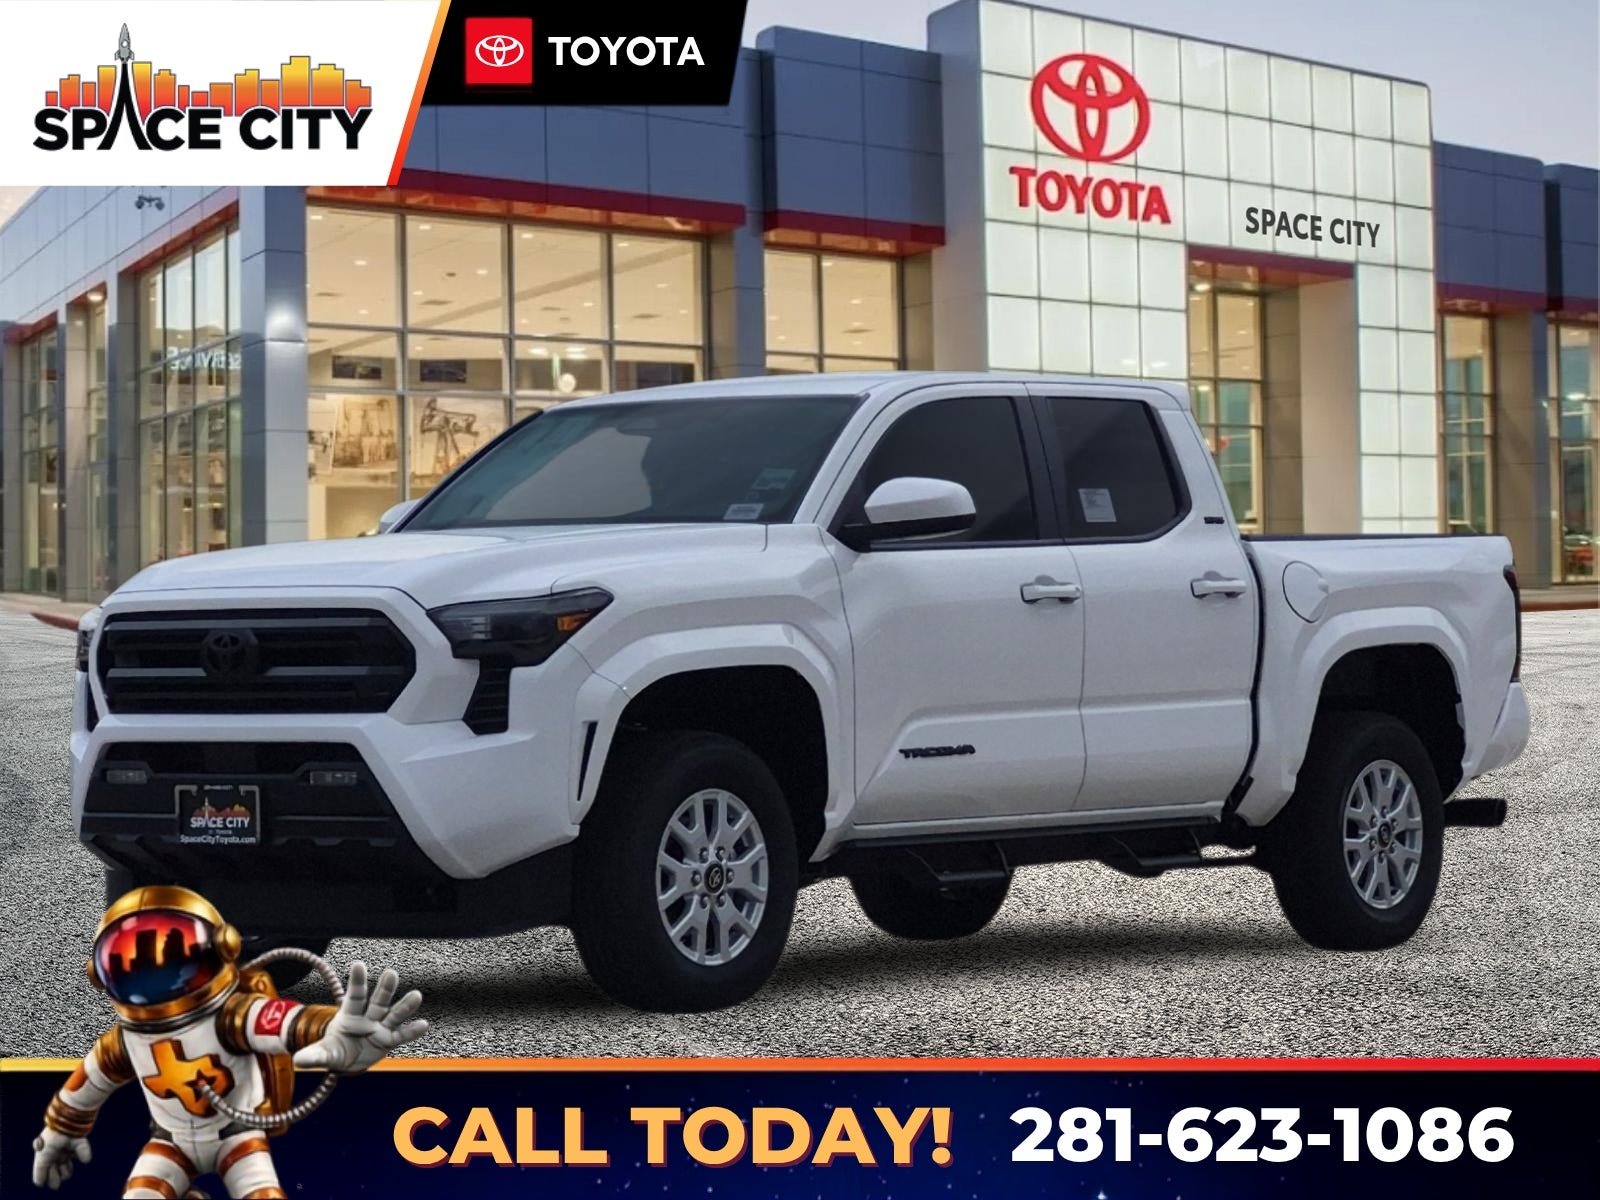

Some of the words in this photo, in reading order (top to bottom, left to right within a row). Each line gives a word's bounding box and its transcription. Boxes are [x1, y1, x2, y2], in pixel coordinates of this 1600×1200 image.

[1008, 165, 1172, 225] TOYOTA
[1245, 206, 1323, 243] SPACE
[1329, 217, 1381, 248] CITY
[190, 816, 224, 828] SPACE
[225, 816, 250, 828] CITY
[180, 834, 257, 845] SpaceCityToyota.com
